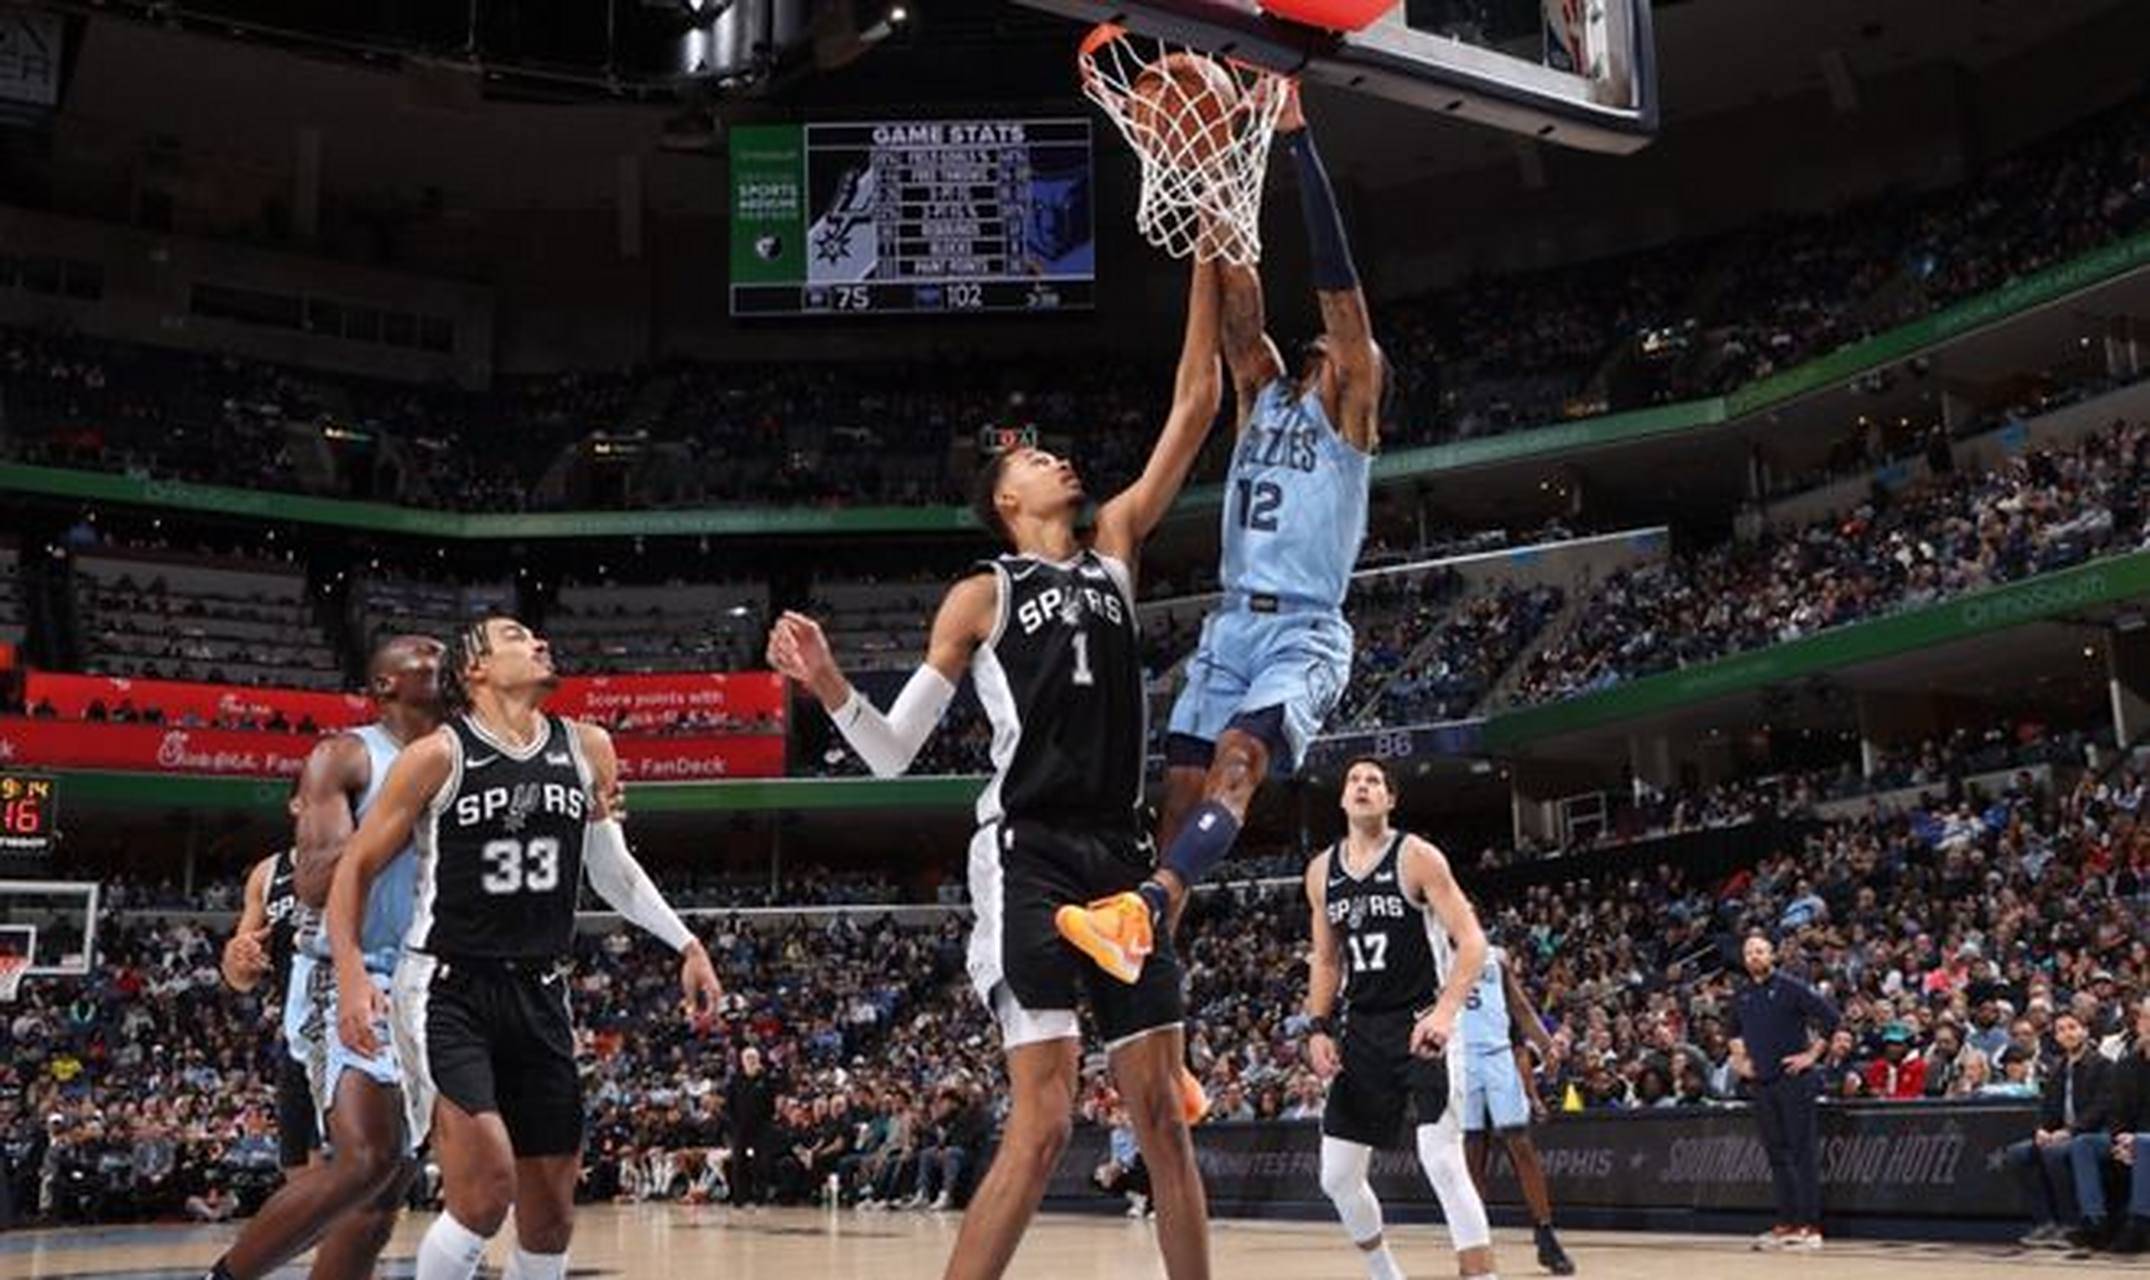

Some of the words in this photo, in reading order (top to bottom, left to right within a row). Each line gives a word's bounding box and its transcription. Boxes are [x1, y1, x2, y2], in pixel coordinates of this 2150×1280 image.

[872, 125, 943, 144] GAME
[951, 124, 1026, 143] STATS
[835, 286, 869, 309] 75
[947, 285, 983, 306] 102
[1237, 478, 1283, 532] 12
[1071, 632, 1094, 686] 1
[640, 755, 727, 774] FanDeck
[481, 836, 561, 894] 33
[1349, 932, 1389, 972] 17
